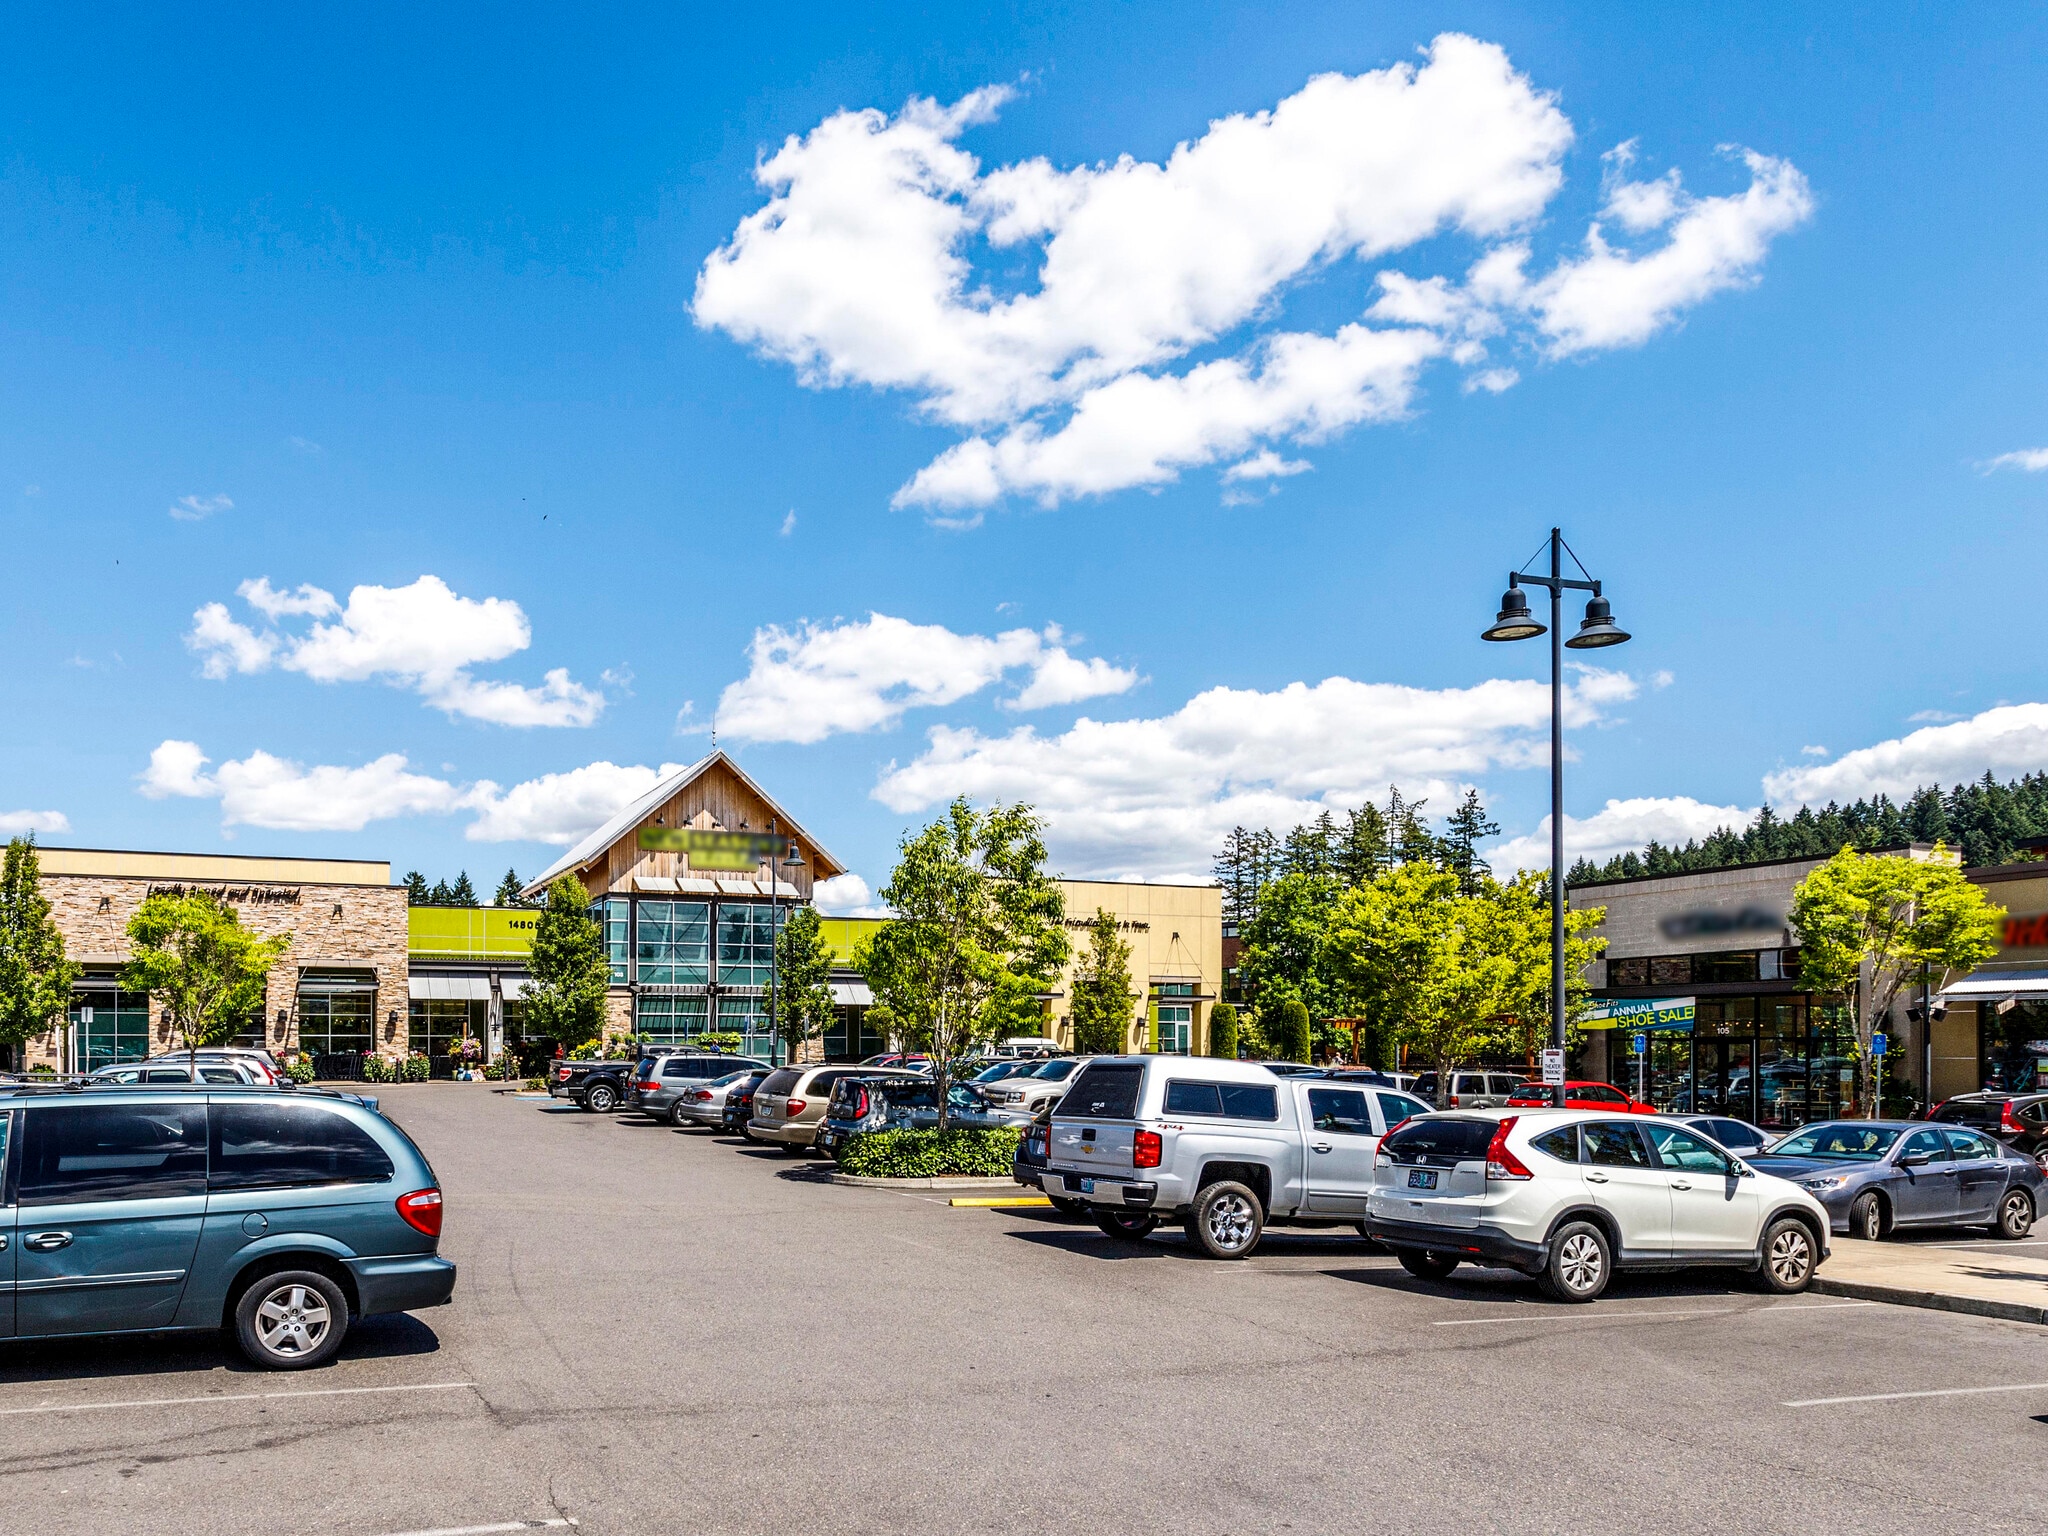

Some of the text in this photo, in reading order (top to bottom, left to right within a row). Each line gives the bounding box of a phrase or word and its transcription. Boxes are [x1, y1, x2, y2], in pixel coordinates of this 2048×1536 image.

[228, 886, 251, 900] and
[1065, 917, 1101, 927] Friendlies
[1612, 1003, 1654, 1017] ANNUAL
[1618, 1012, 1656, 1029] SHOE
[1717, 1027, 1730, 1035] 105
